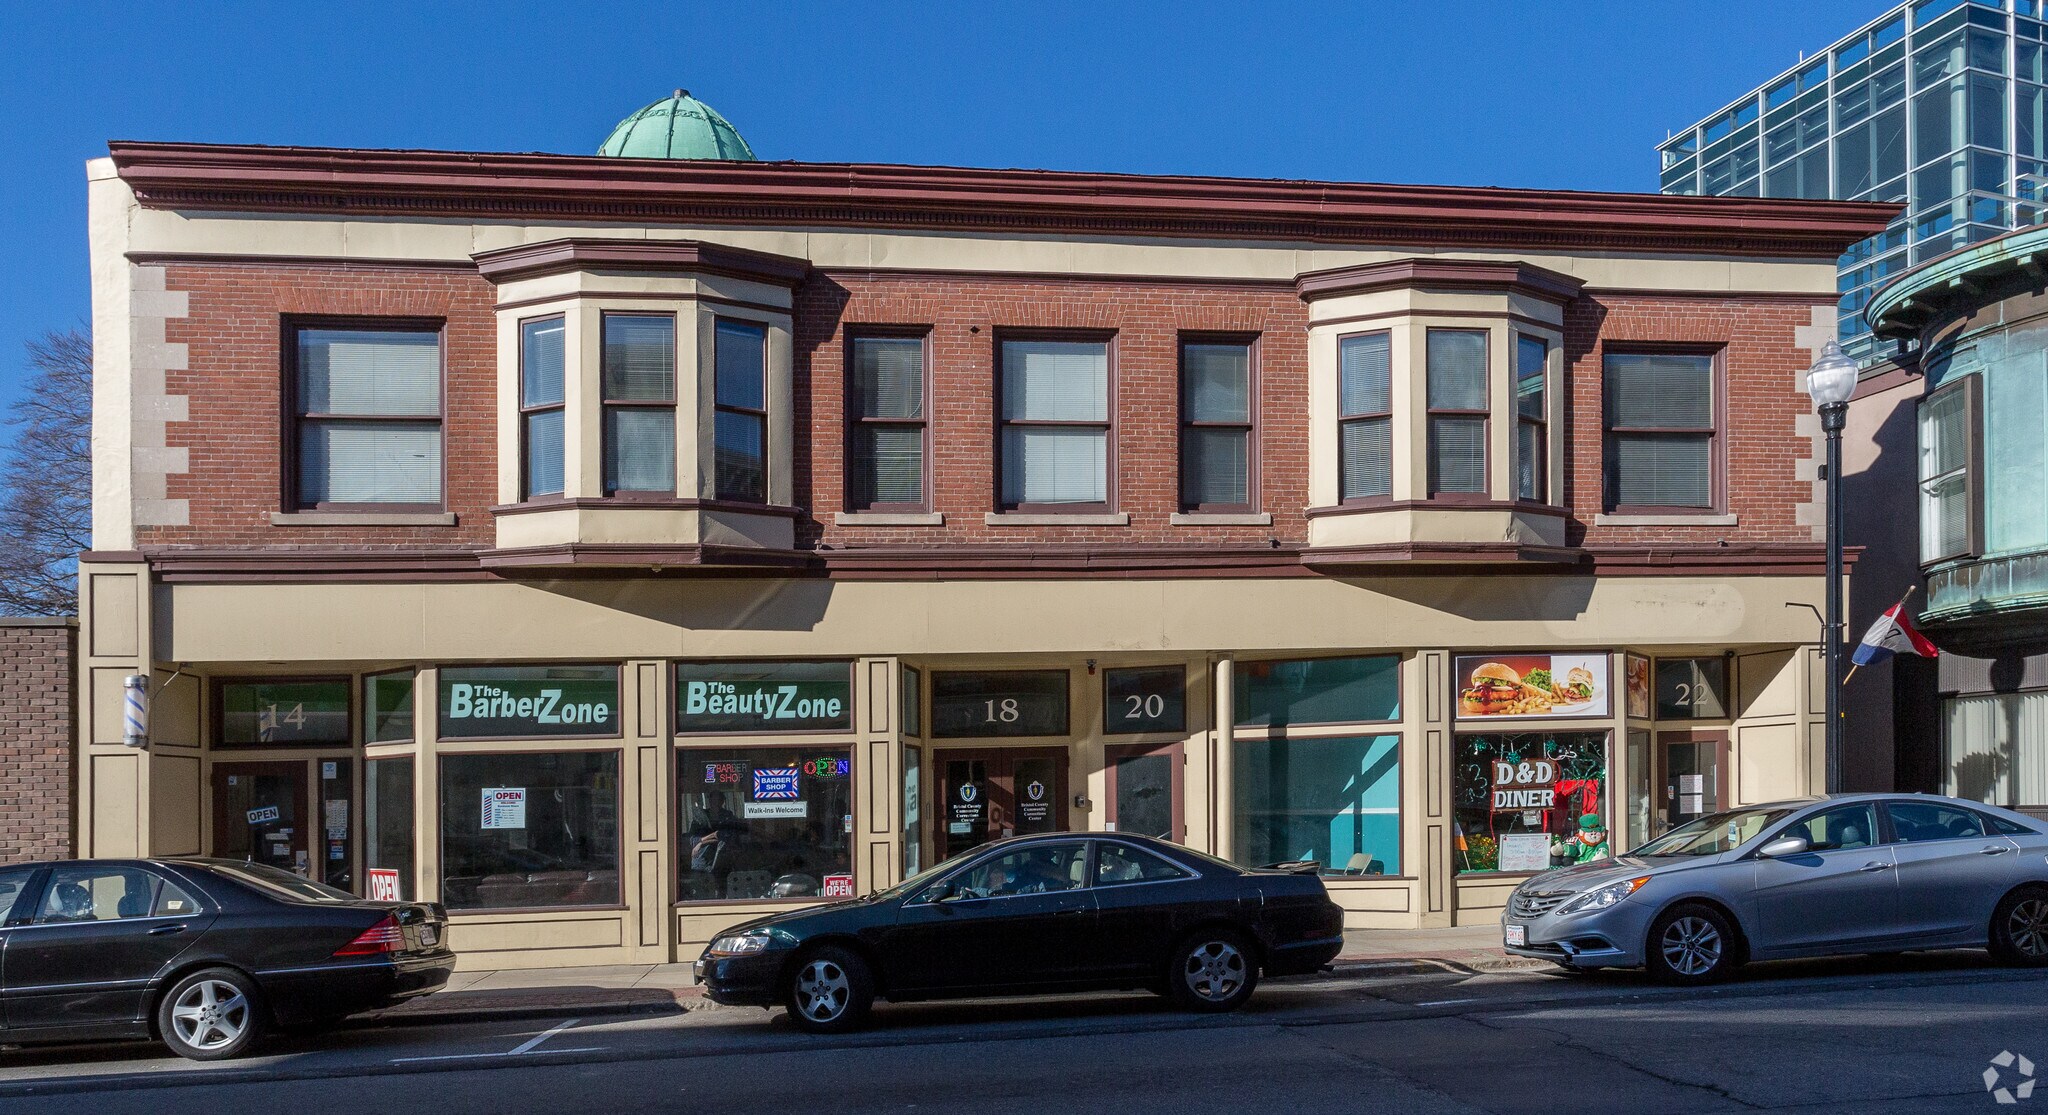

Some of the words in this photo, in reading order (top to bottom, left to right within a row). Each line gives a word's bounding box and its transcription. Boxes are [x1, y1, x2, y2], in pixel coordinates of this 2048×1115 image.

[474, 685, 500, 697] The
[708, 682, 735, 694] The
[1675, 683, 1709, 705] 22
[450, 684, 608, 724] BarberZone
[686, 681, 841, 719] BeautyZone
[1125, 694, 1164, 719] 20
[267, 702, 307, 730] 14
[984, 698, 1019, 722] 18
[716, 763, 748, 773] BARBER
[804, 760, 848, 775] OPEN
[720, 773, 744, 783] SHOP
[496, 792, 522, 800] OPEN
[1494, 789, 1555, 808] DINER
[249, 808, 278, 821] OPEN
[748, 806, 774, 815] Walk-Ins
[775, 806, 804, 814] Welcome
[372, 874, 399, 901] OPEN
[826, 885, 852, 896] OPEN
